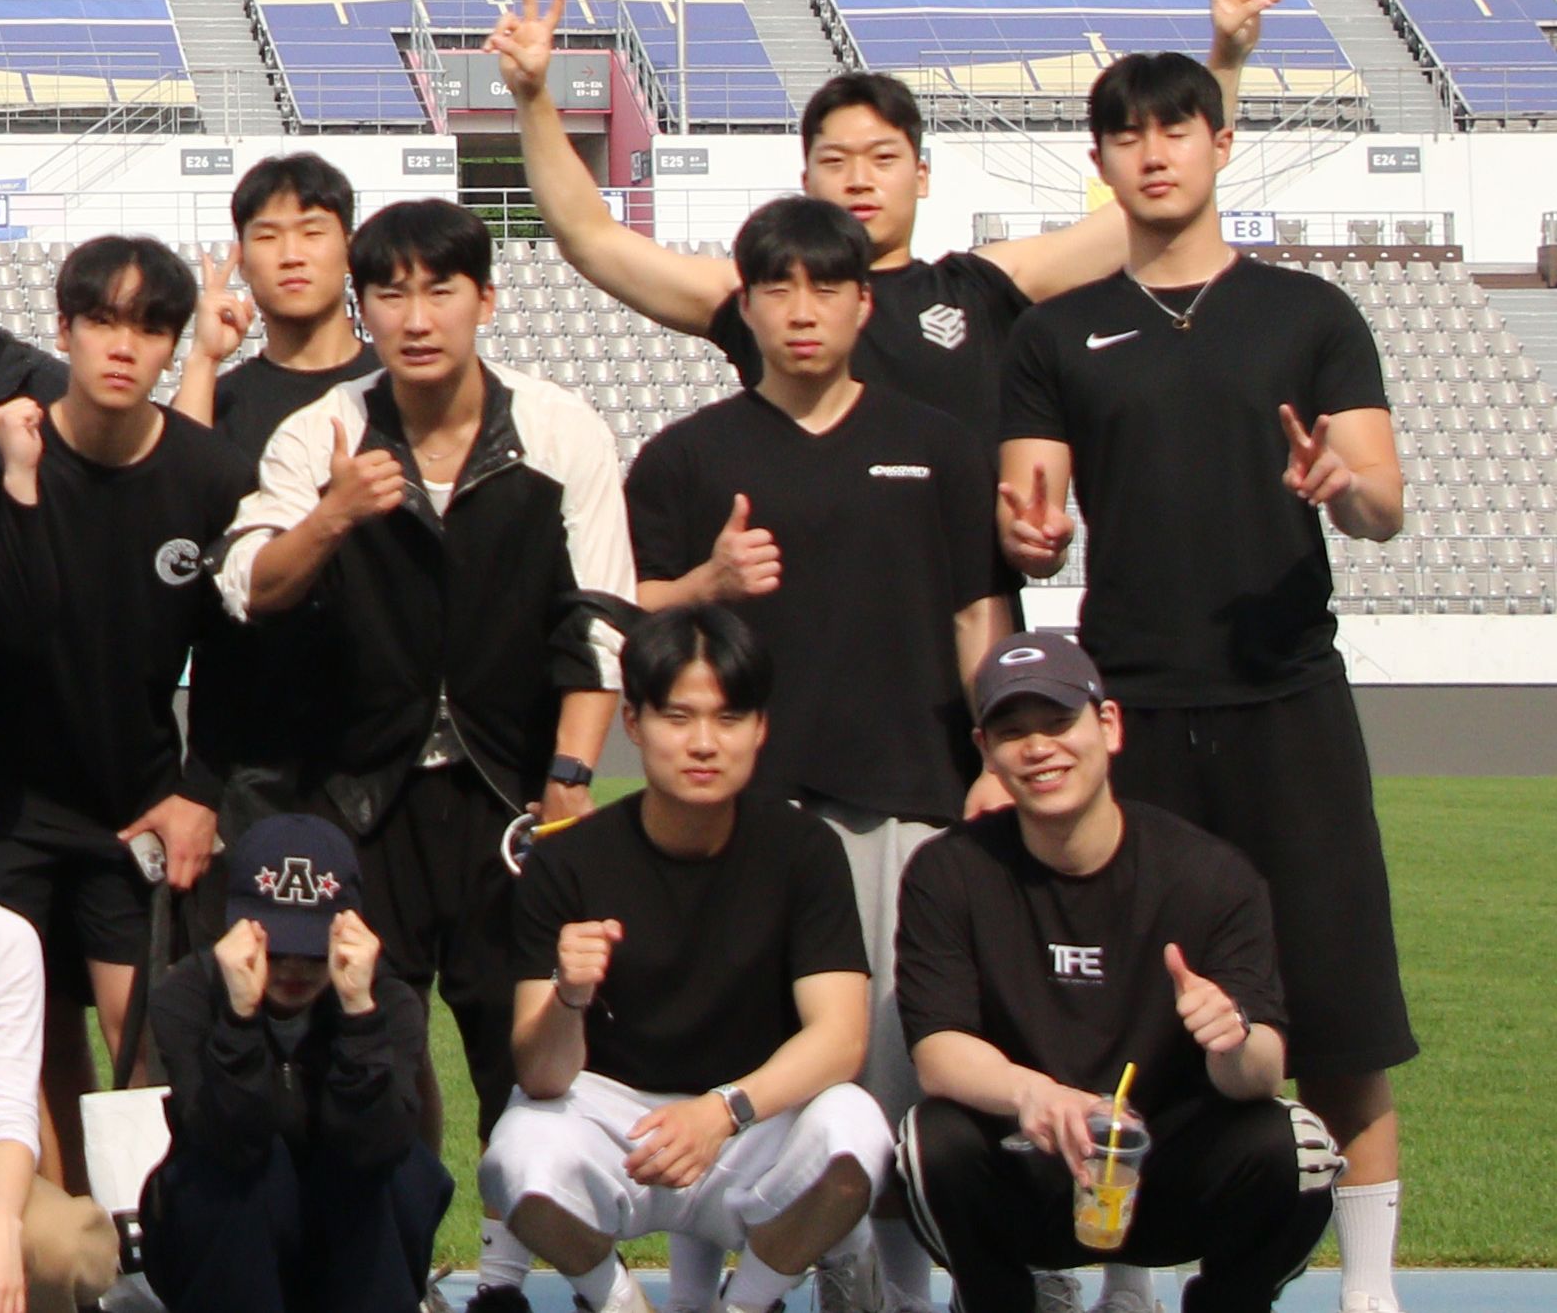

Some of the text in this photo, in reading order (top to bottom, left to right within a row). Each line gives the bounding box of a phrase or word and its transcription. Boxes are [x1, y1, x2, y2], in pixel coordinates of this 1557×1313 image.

[185, 156, 210, 168] E26
[407, 156, 431, 168] E25
[660, 156, 684, 168] E25
[1372, 154, 1397, 166] E24
[1234, 221, 1262, 239] E8
[274, 857, 318, 903] A
